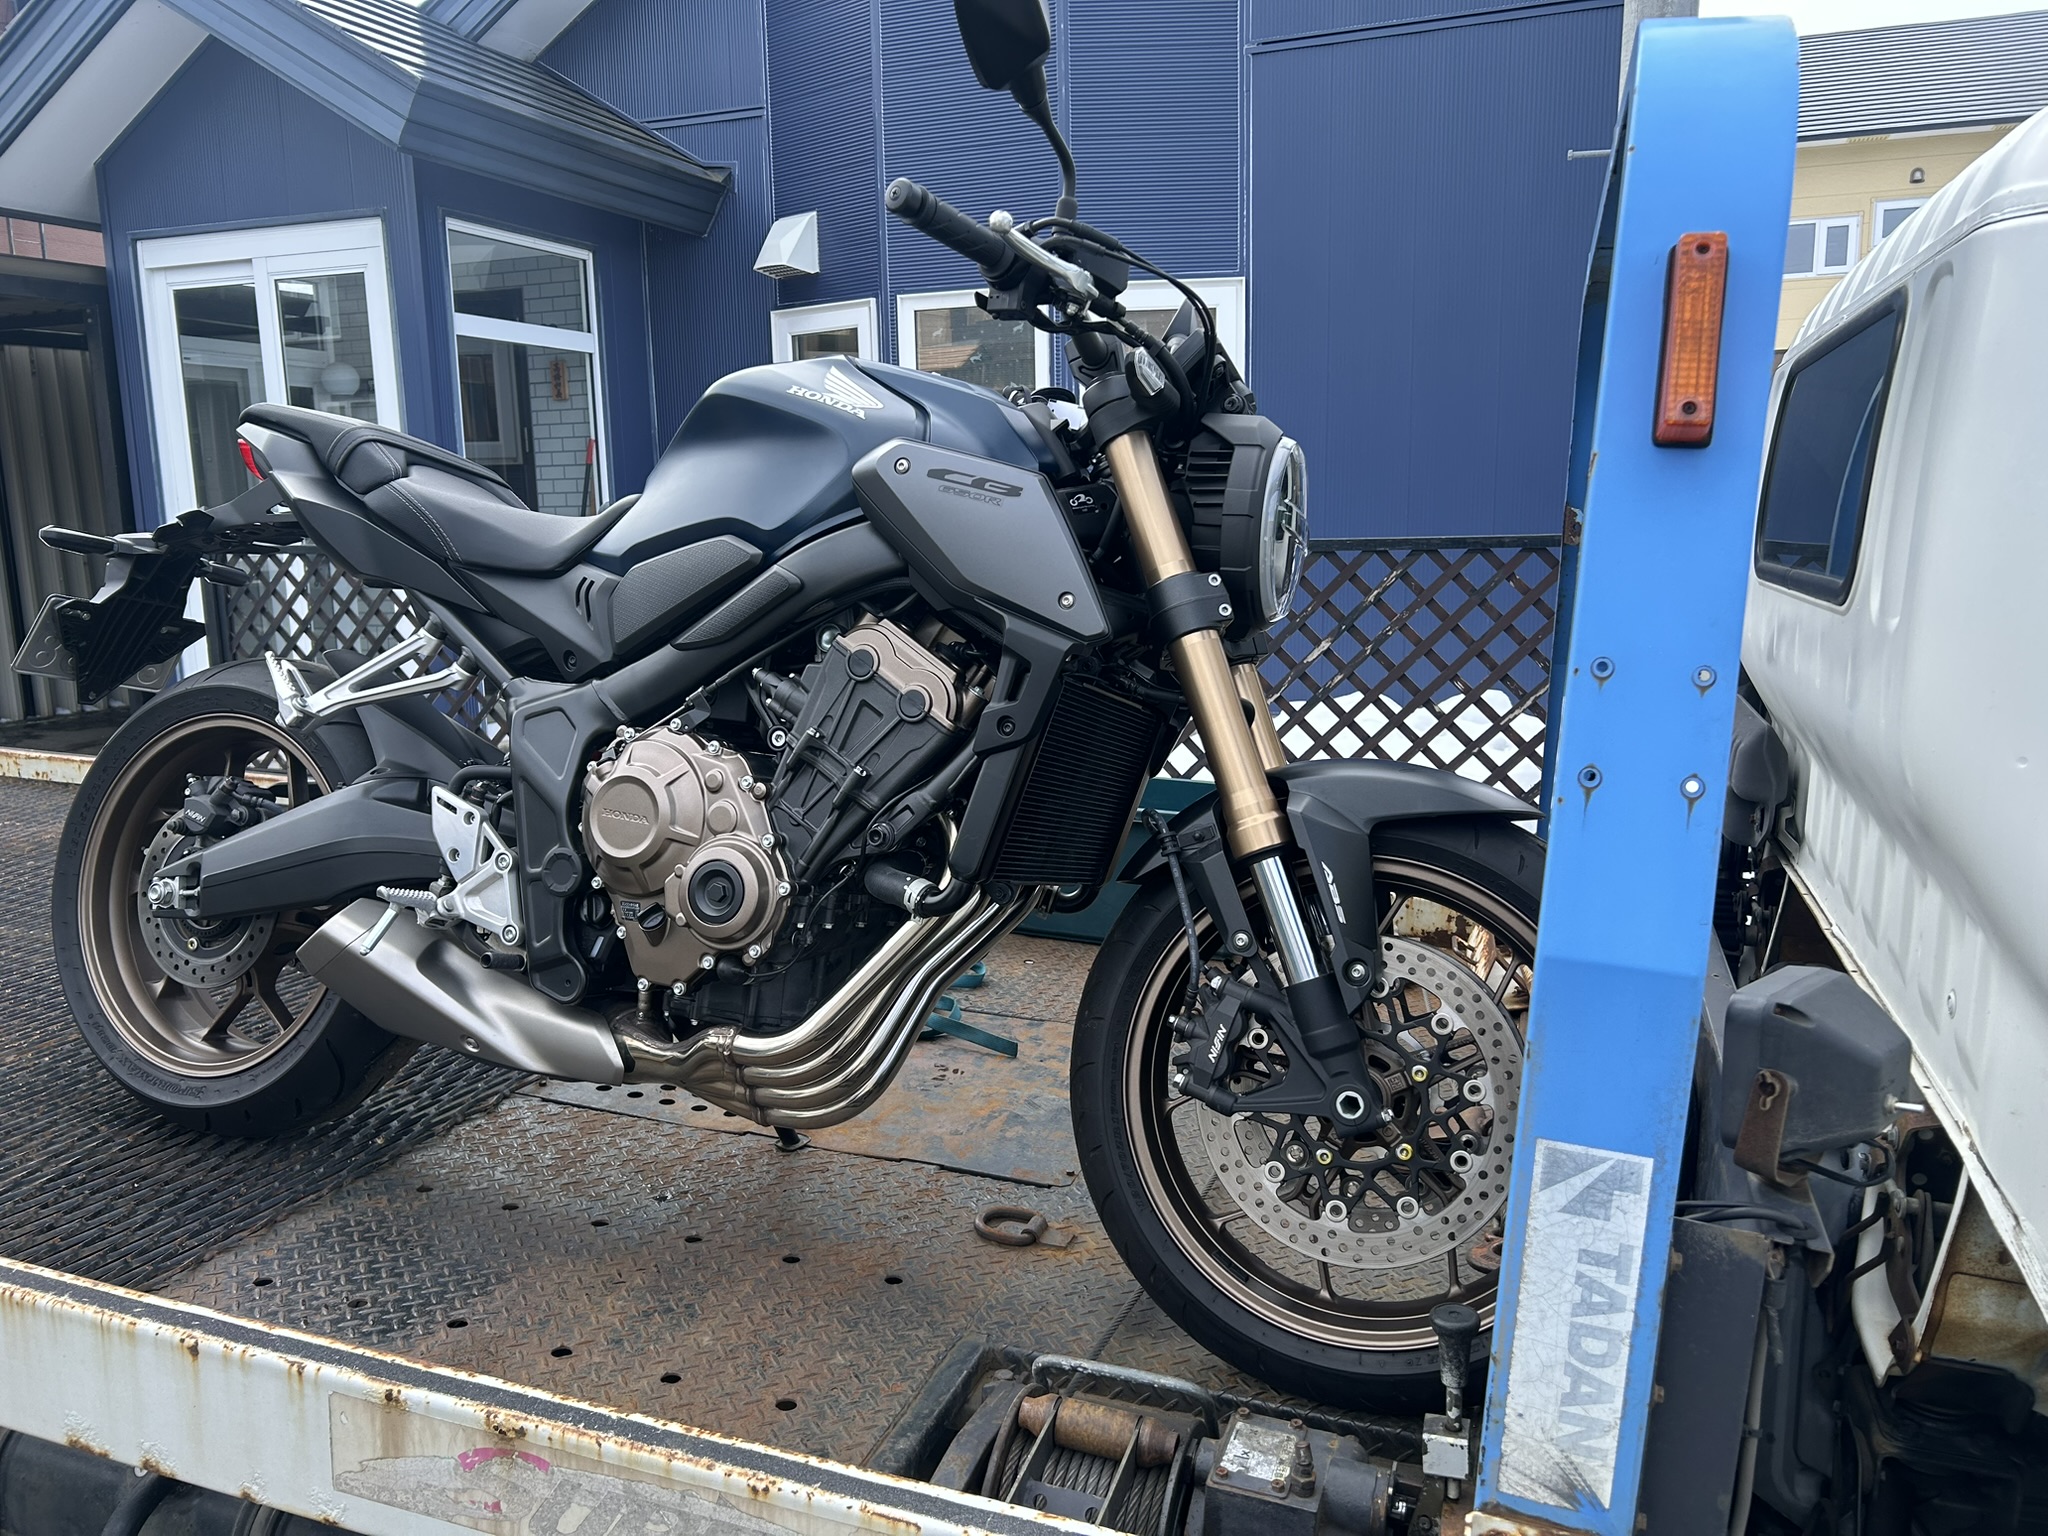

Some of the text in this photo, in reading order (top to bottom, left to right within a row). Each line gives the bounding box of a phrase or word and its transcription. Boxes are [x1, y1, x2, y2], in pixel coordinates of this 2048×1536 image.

[786, 385, 866, 420] HONDA
[926, 468, 1024, 497] CB
[601, 807, 650, 825] HONDA
[1321, 861, 1347, 924] ABS
